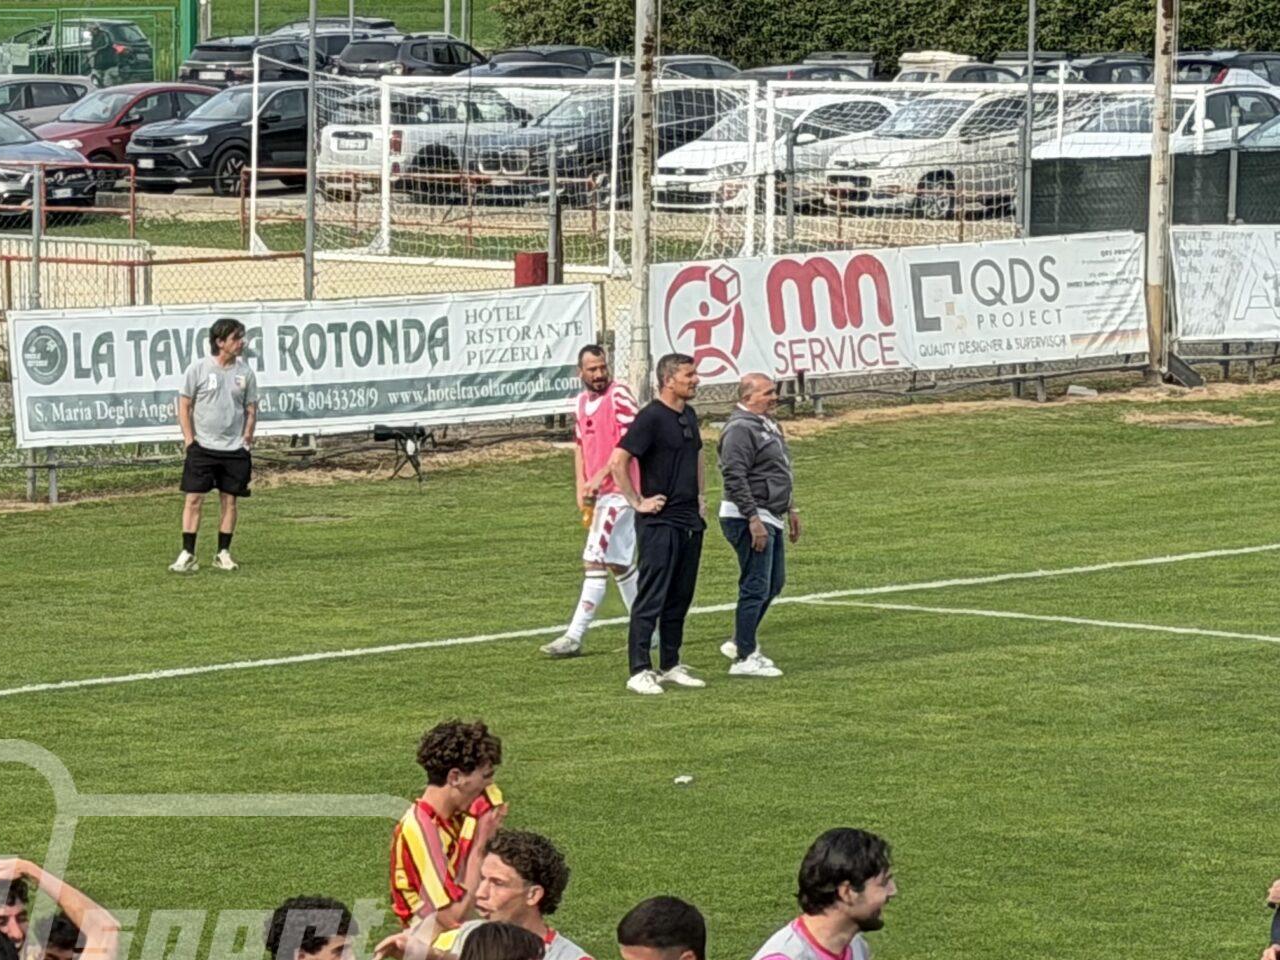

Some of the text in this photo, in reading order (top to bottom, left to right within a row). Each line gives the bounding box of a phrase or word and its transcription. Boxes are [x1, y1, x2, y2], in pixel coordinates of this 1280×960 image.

[970, 255, 1060, 306] QDS
[465, 304, 525, 325] HOTEL
[977, 309, 1062, 330] PROJECT
[465, 320, 583, 346] RISTORANTE
[919, 334, 1066, 357] QUALITY DESIGNER & SUPERVISOR
[73, 331, 116, 384] LA
[277, 315, 451, 377] ROTONDA
[466, 343, 553, 366] PIZZERIA
[774, 332, 899, 375] SERVICE
[34, 403, 48, 423] S.
[52, 400, 92, 423] Maria
[96, 398, 134, 425] Degli
[138, 396, 179, 422] Angel
[257, 393, 275, 413] el.
[278, 392, 305, 412] 075
[308, 387, 379, 411] 8043328/9
